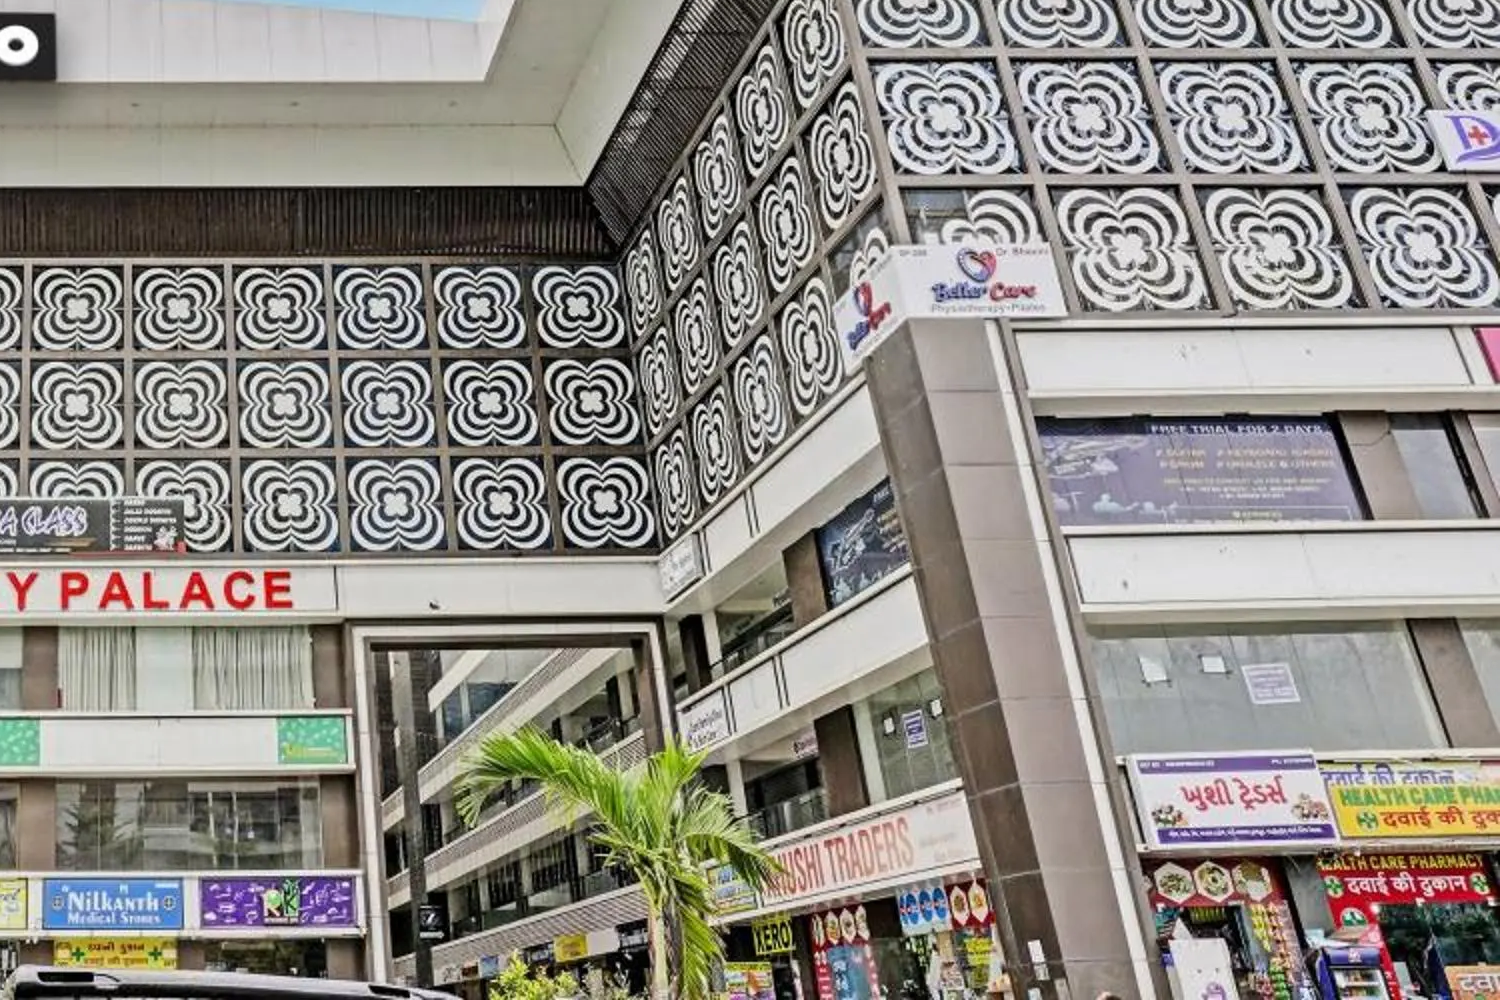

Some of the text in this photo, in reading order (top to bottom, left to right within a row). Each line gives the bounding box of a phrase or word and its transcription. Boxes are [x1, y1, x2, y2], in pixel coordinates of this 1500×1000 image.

[989, 282, 1037, 302] Care
[1151, 425, 1188, 435] FREE
[1190, 425, 1231, 435] TRIAL
[1237, 425, 1268, 435] FOR
[21, 505, 88, 538] CLASS
[59, 571, 295, 611] PALACE
[1338, 787, 1408, 807] HEALTH
[1410, 786, 1457, 806] CARE
[1379, 805, 1433, 829] दवाई
[1436, 804, 1466, 826] की
[822, 815, 915, 884] TRADERS
[1369, 854, 1409, 870] CARE
[1409, 853, 1485, 870] PHARMACY
[1343, 871, 1469, 898] दवाई की दुकान
[756, 920, 792, 954] XERO
